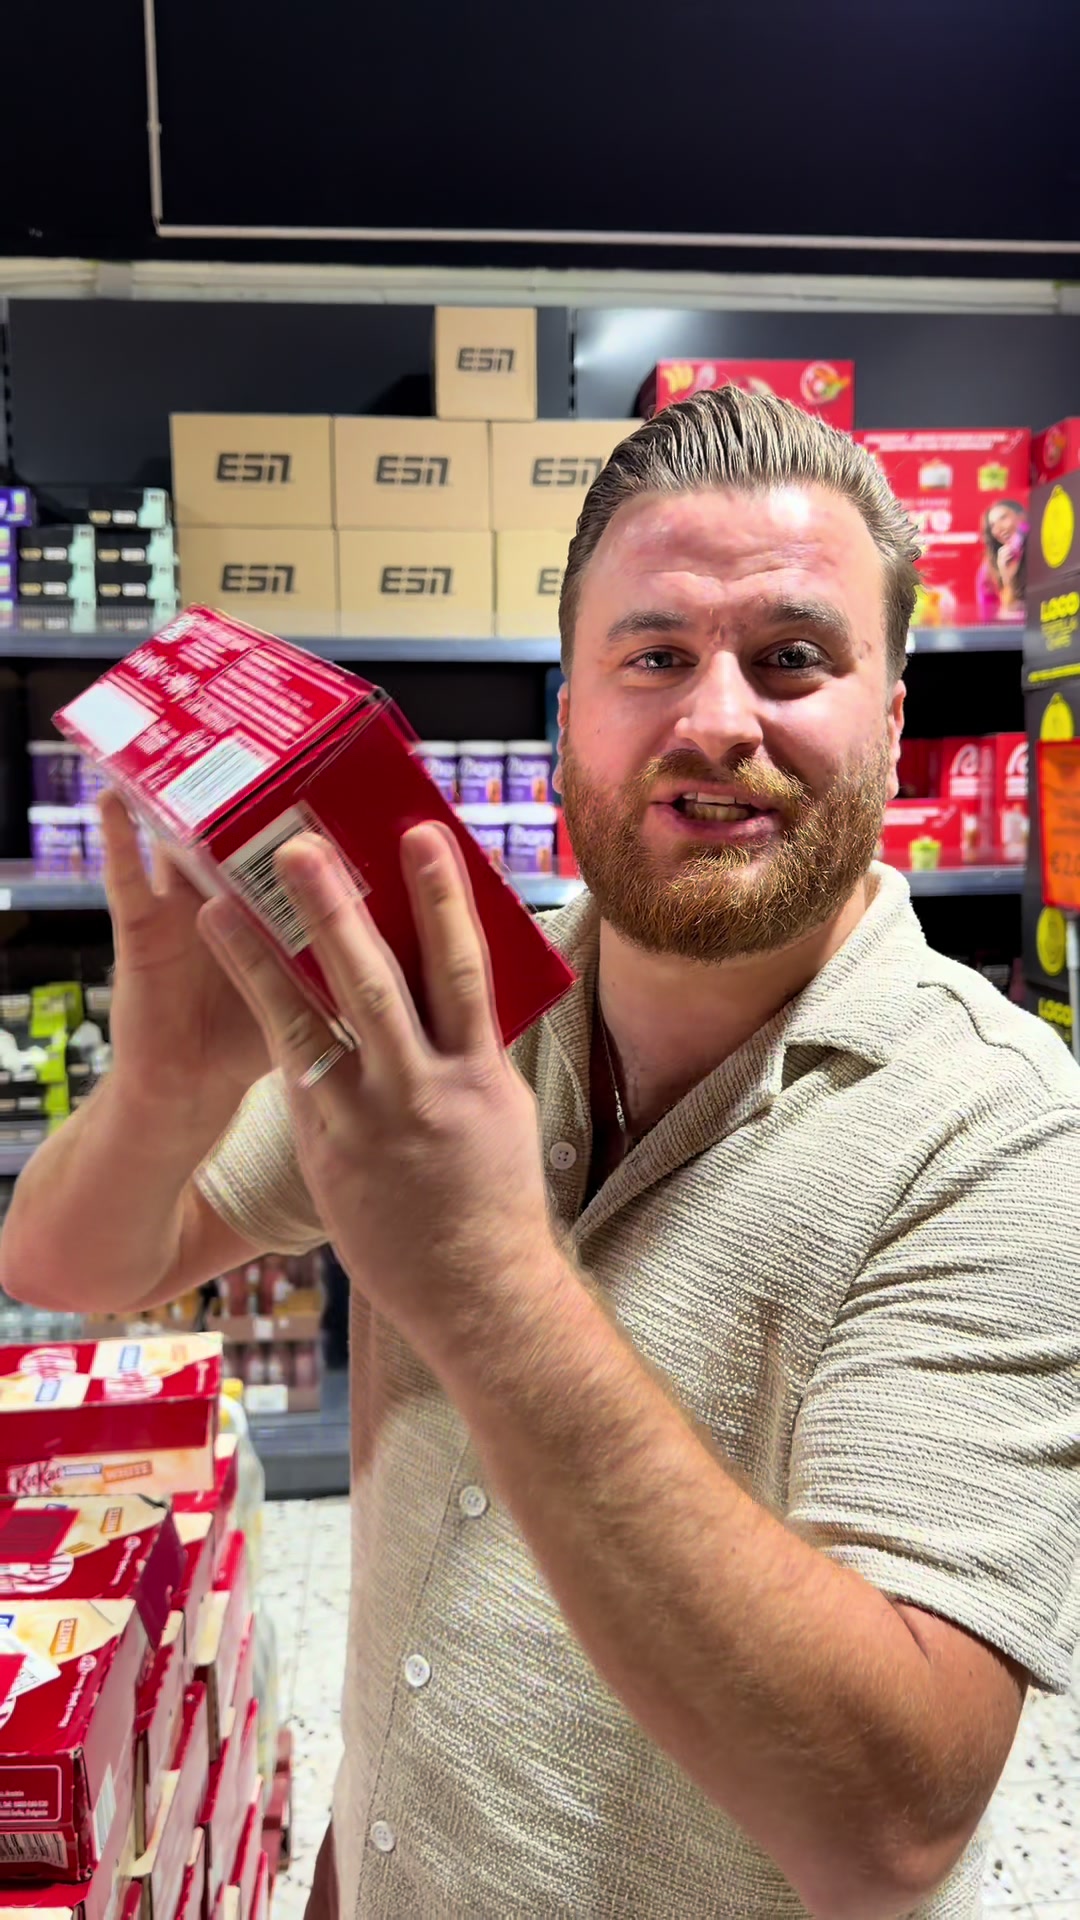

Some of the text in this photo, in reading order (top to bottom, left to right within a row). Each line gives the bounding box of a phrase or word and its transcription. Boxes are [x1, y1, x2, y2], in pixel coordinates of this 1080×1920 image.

[457, 347, 515, 373] ESN
[215, 453, 292, 483] ESN
[374, 455, 449, 486] ESN
[220, 563, 295, 593] ESN
[379, 566, 453, 595] ESN
[1040, 592, 1080, 623] LOCO
